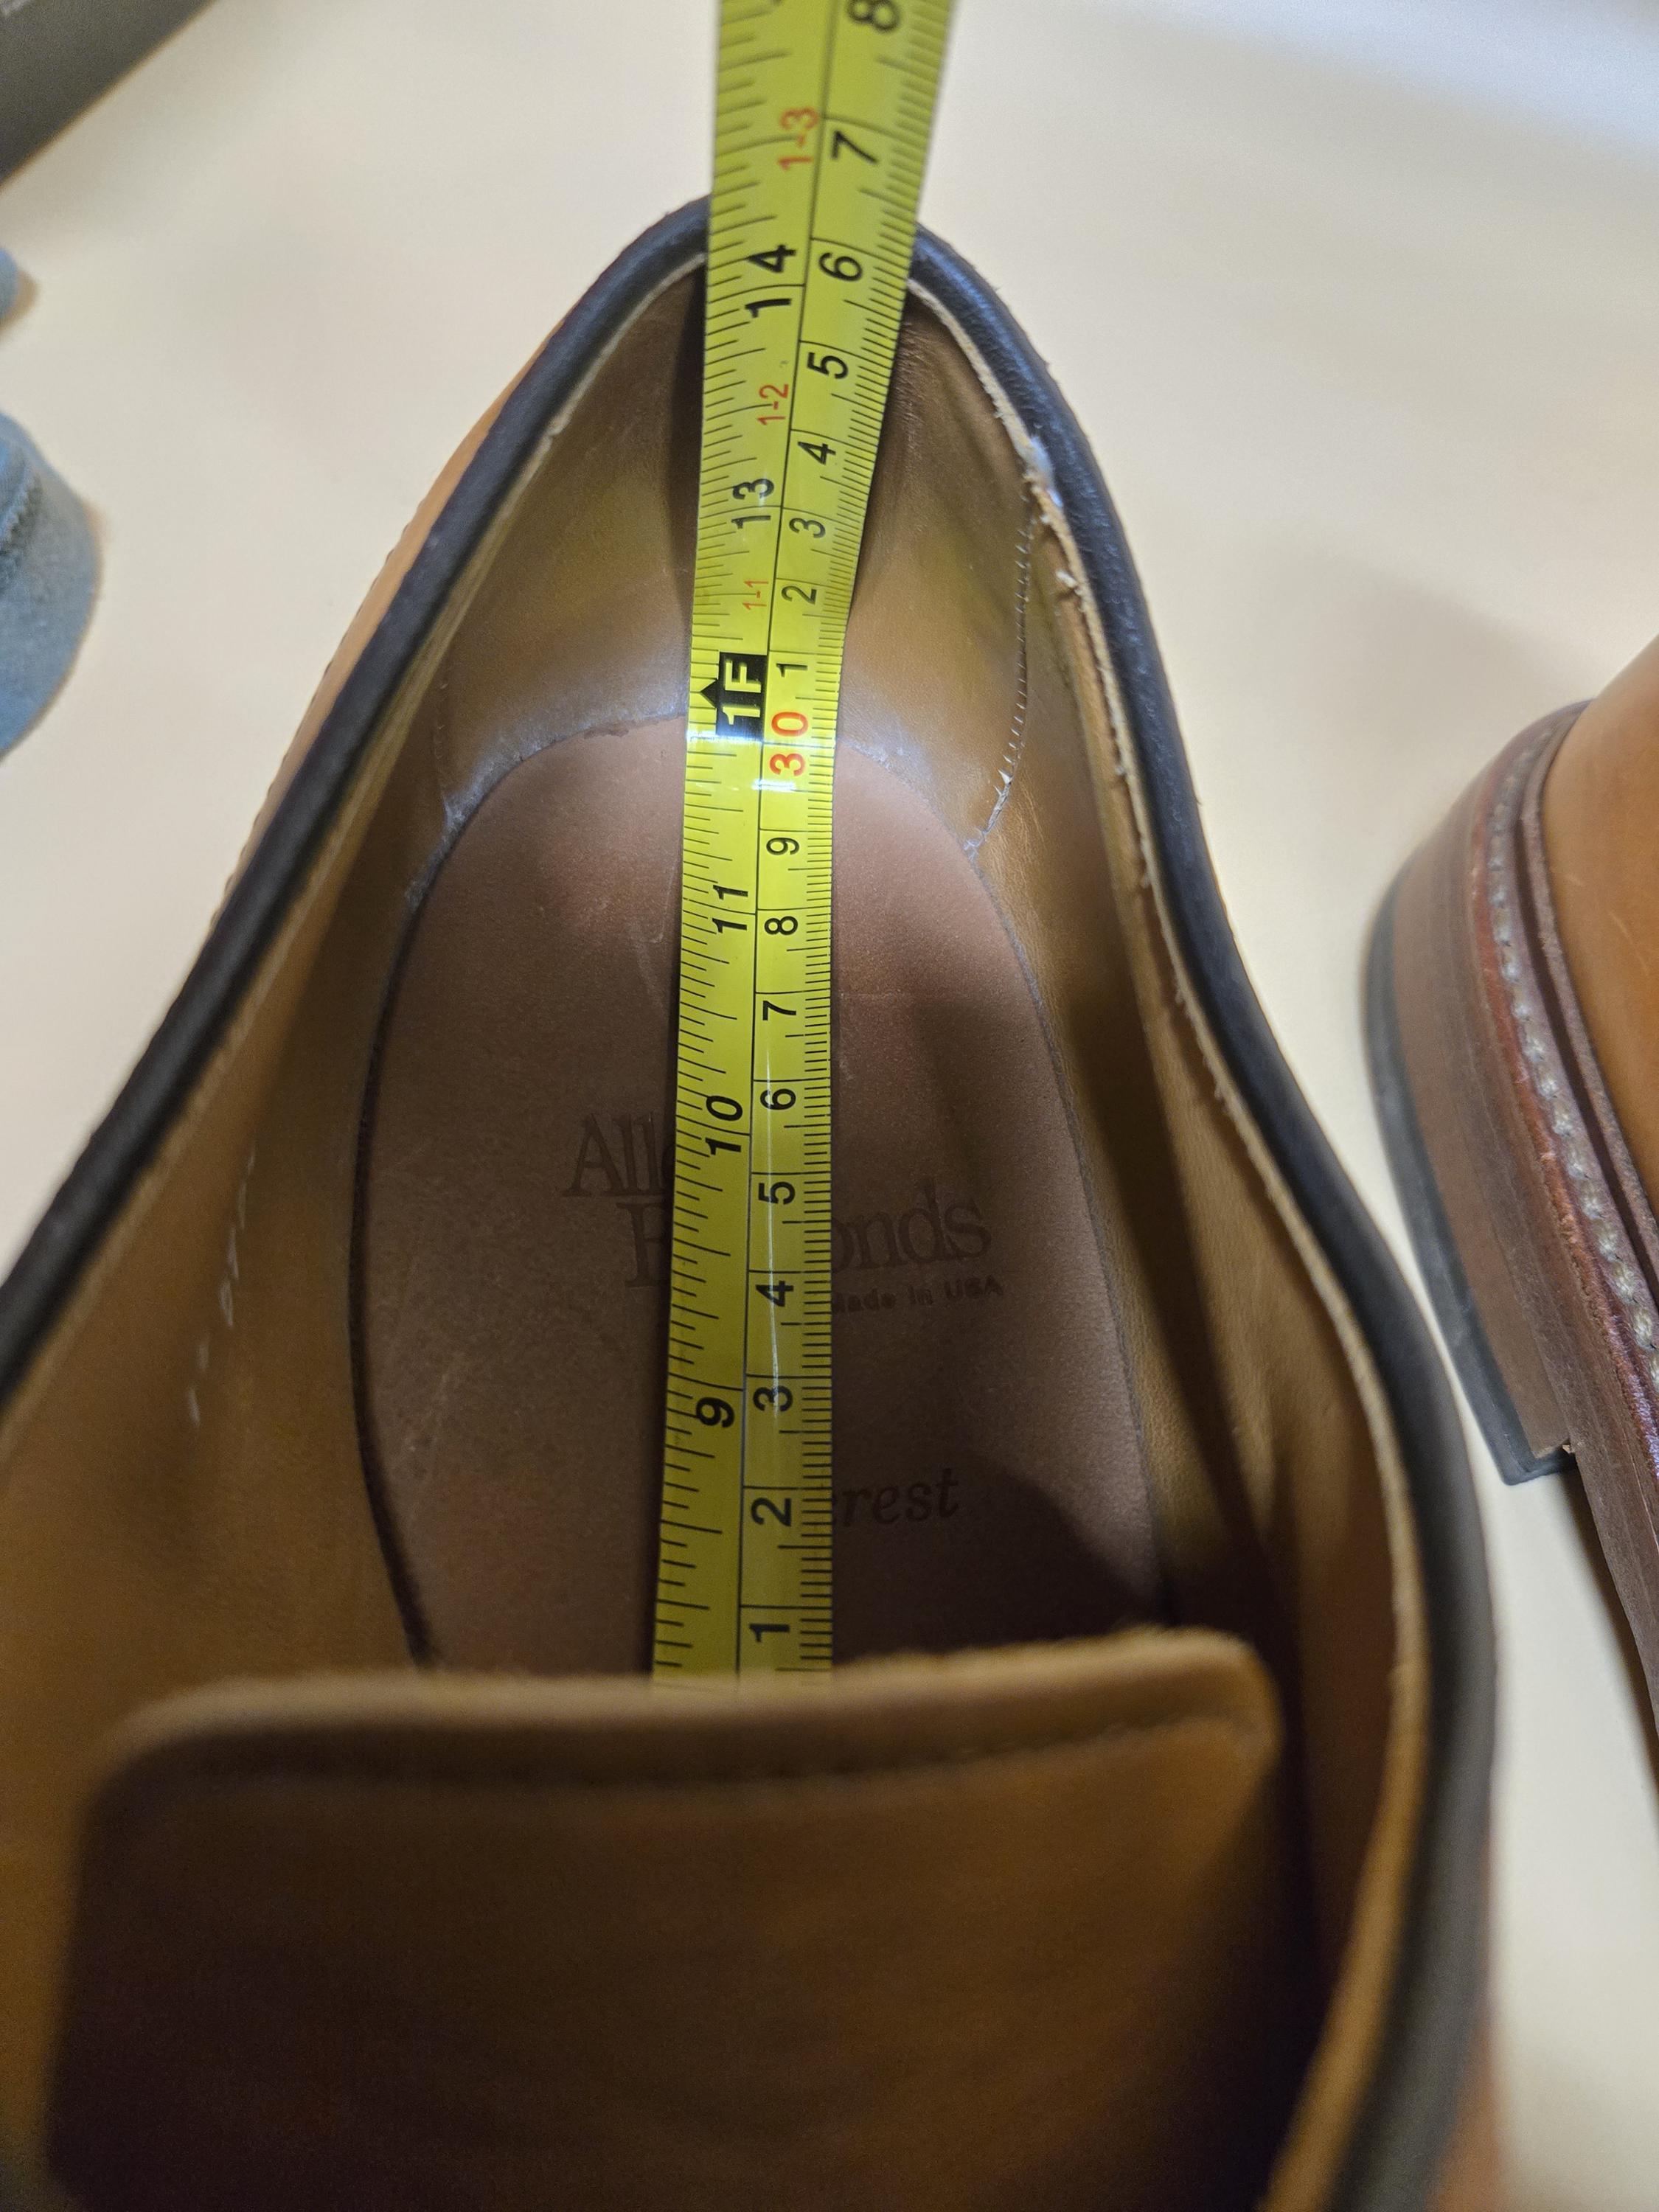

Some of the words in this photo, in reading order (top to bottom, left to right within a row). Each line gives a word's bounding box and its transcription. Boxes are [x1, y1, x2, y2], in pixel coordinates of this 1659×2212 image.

[830, 130, 881, 166] 7
[745, 243, 797, 319] 14
[818, 252, 863, 282] 6
[807, 352, 849, 379] 5
[797, 440, 837, 465] 4
[731, 477, 775, 530] 13
[788, 517, 827, 539] 3
[781, 585, 818, 605] 2
[776, 662, 808, 678] 1
[722, 659, 762, 726] 1F
[769, 711, 809, 777] 30
[765, 837, 801, 856] 9
[712, 884, 749, 934] 11
[764, 915, 799, 936] 8
[762, 1000, 797, 1021] 7
[759, 1088, 796, 1111] 6
[704, 1095, 744, 1155] 10
[561, 1112, 669, 1197] All
[758, 1181, 796, 1205] 5
[755, 1279, 794, 1307] 4
[944, 1275, 1004, 1302] USA
[695, 1396, 736, 1428] 9
[753, 1385, 794, 1413] 3
[833, 1467, 959, 1527] rest
[750, 1497, 792, 1527] 2
[749, 1624, 790, 1644] 1
